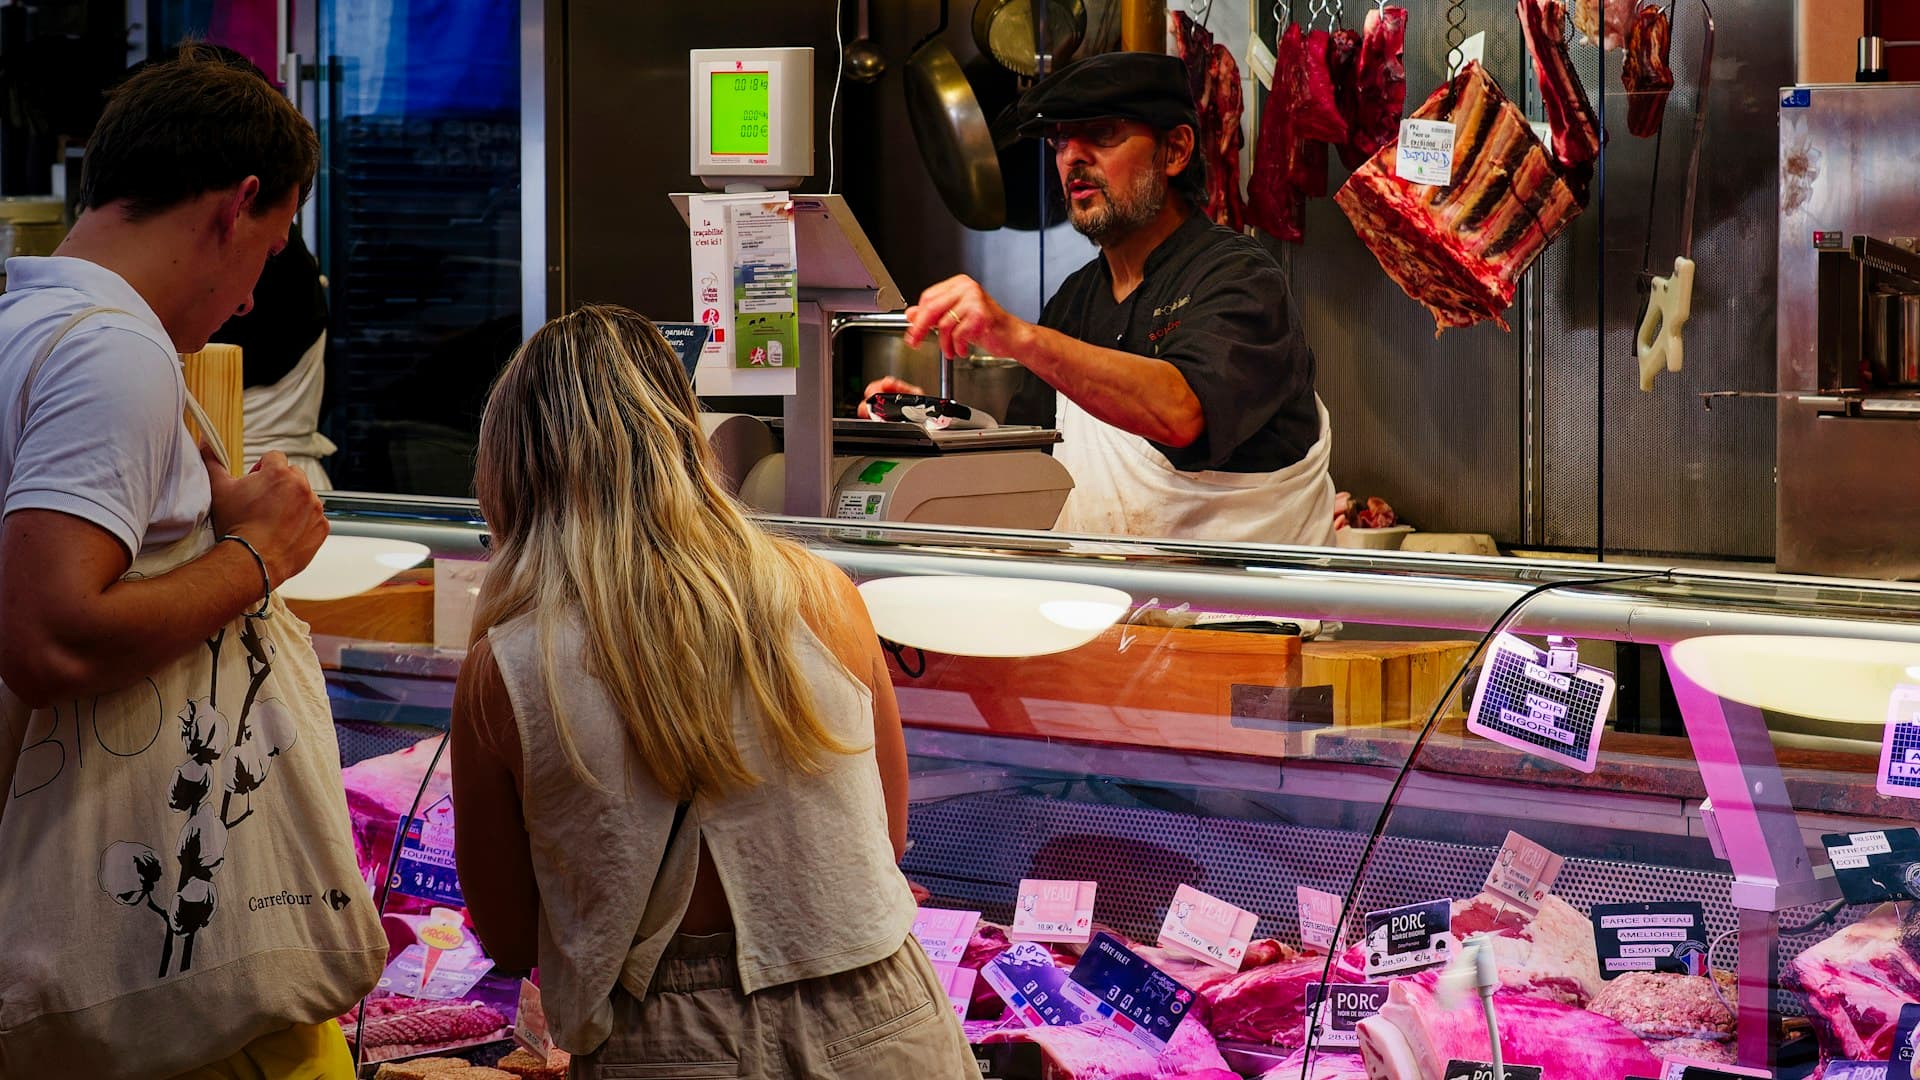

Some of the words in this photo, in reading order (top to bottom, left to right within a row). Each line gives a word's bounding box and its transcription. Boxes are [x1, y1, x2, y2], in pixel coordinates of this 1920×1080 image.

[693, 228, 723, 237] traçabilité
[696, 238, 709, 246] c'est
[665, 326, 694, 338] garantie
[1528, 665, 1568, 688] PORC
[1528, 696, 1563, 715] NOIR
[1532, 709, 1553, 722] DE
[1503, 712, 1568, 741] BIGORRE
[1520, 846, 1545, 870] VEAU
[248, 890, 313, 912] Carrefour
[1043, 886, 1073, 900] VEAU
[1200, 898, 1231, 925] VEAU
[1602, 917, 1640, 925] FARCE
[1662, 915, 1691, 923] VEAU
[1391, 911, 1426, 934] PORC
[422, 926, 462, 946] PROMO
[1113, 949, 1130, 966] FILET
[1623, 946, 1670, 954] 15.50/KG
[1337, 993, 1379, 1010] PORC
